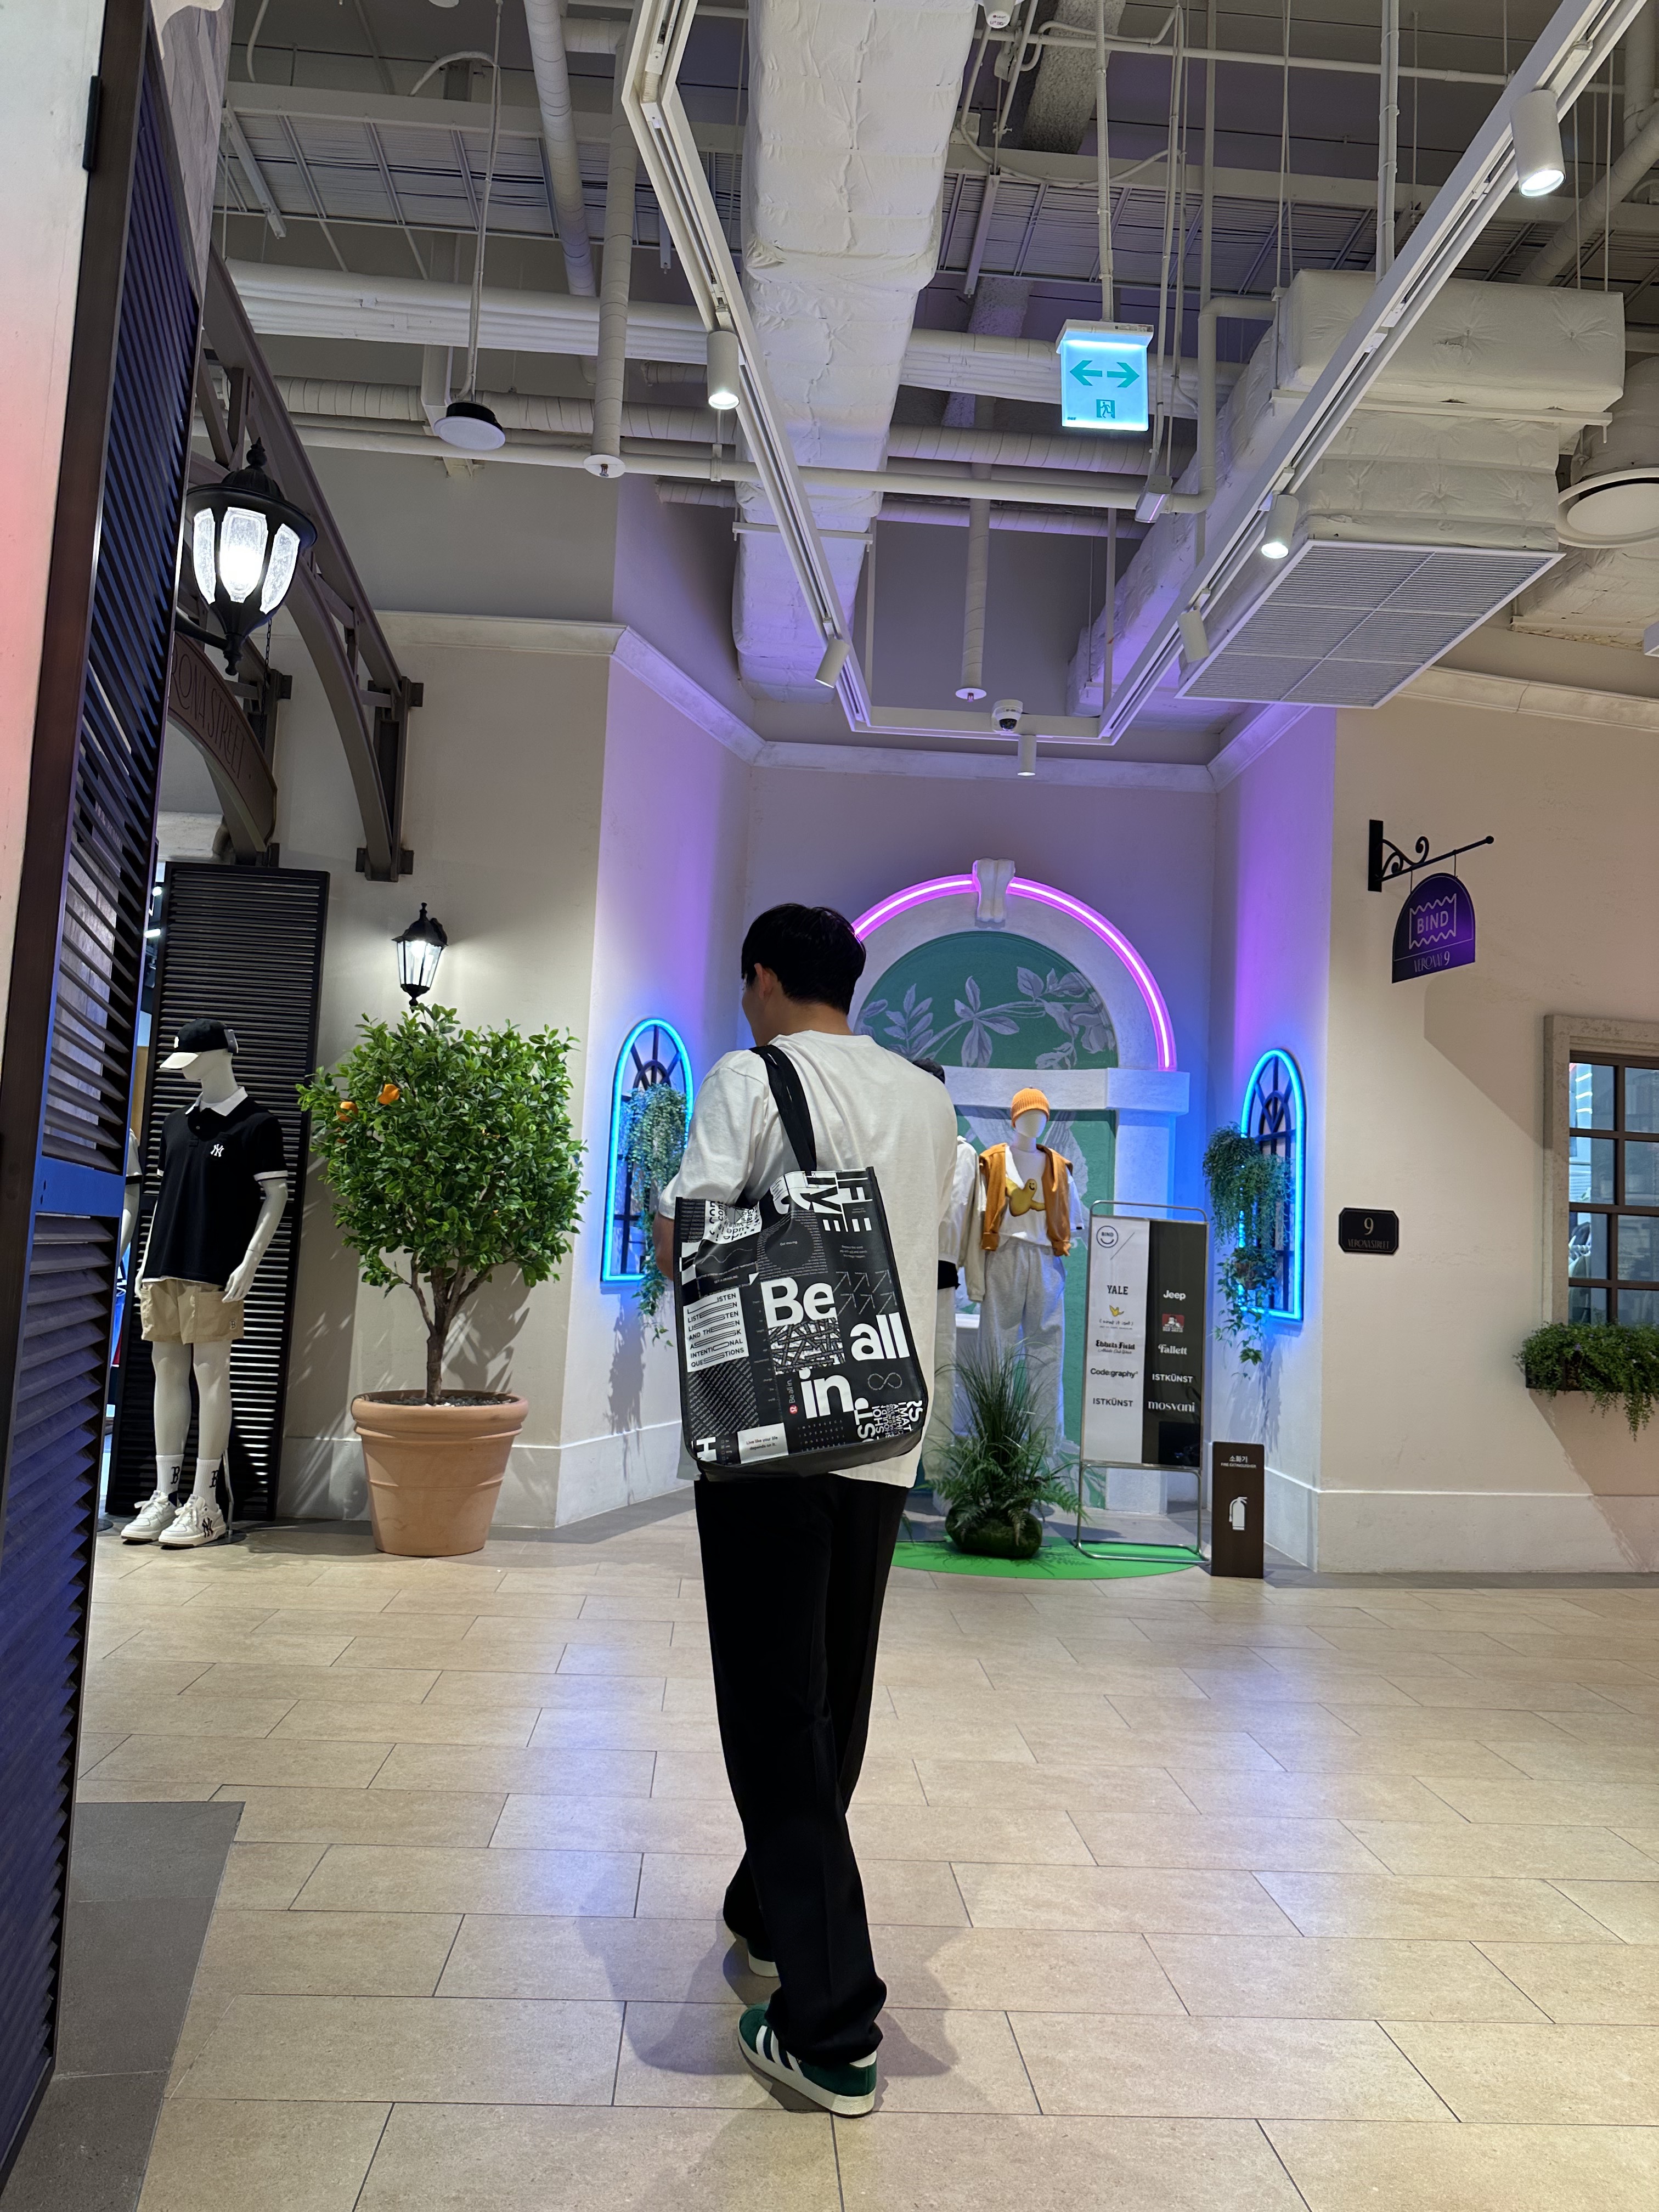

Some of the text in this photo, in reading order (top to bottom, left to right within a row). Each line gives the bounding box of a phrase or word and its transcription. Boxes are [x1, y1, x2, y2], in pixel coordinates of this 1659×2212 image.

[207, 688, 245, 779] STREET
[1417, 911, 1448, 934] BIND
[1444, 951, 1450, 966] 9
[210, 1143, 224, 1157] NY
[1364, 1217, 1374, 1235] 9
[1107, 1285, 1128, 1295] YALE
[1163, 1290, 1186, 1301] Jeep
[761, 1277, 837, 1328] Be
[689, 1332, 701, 1340] AND
[850, 1312, 910, 1361] all
[690, 1339, 743, 1358] INTENTIONAL
[691, 1348, 744, 1367] QUESTIONS
[1158, 1344, 1187, 1355] Fallett
[788, 1394, 795, 1403] Be
[1148, 1401, 1195, 1412] mosvani
[171, 1466, 180, 1484] B
[202, 1516, 213, 1538] NY
